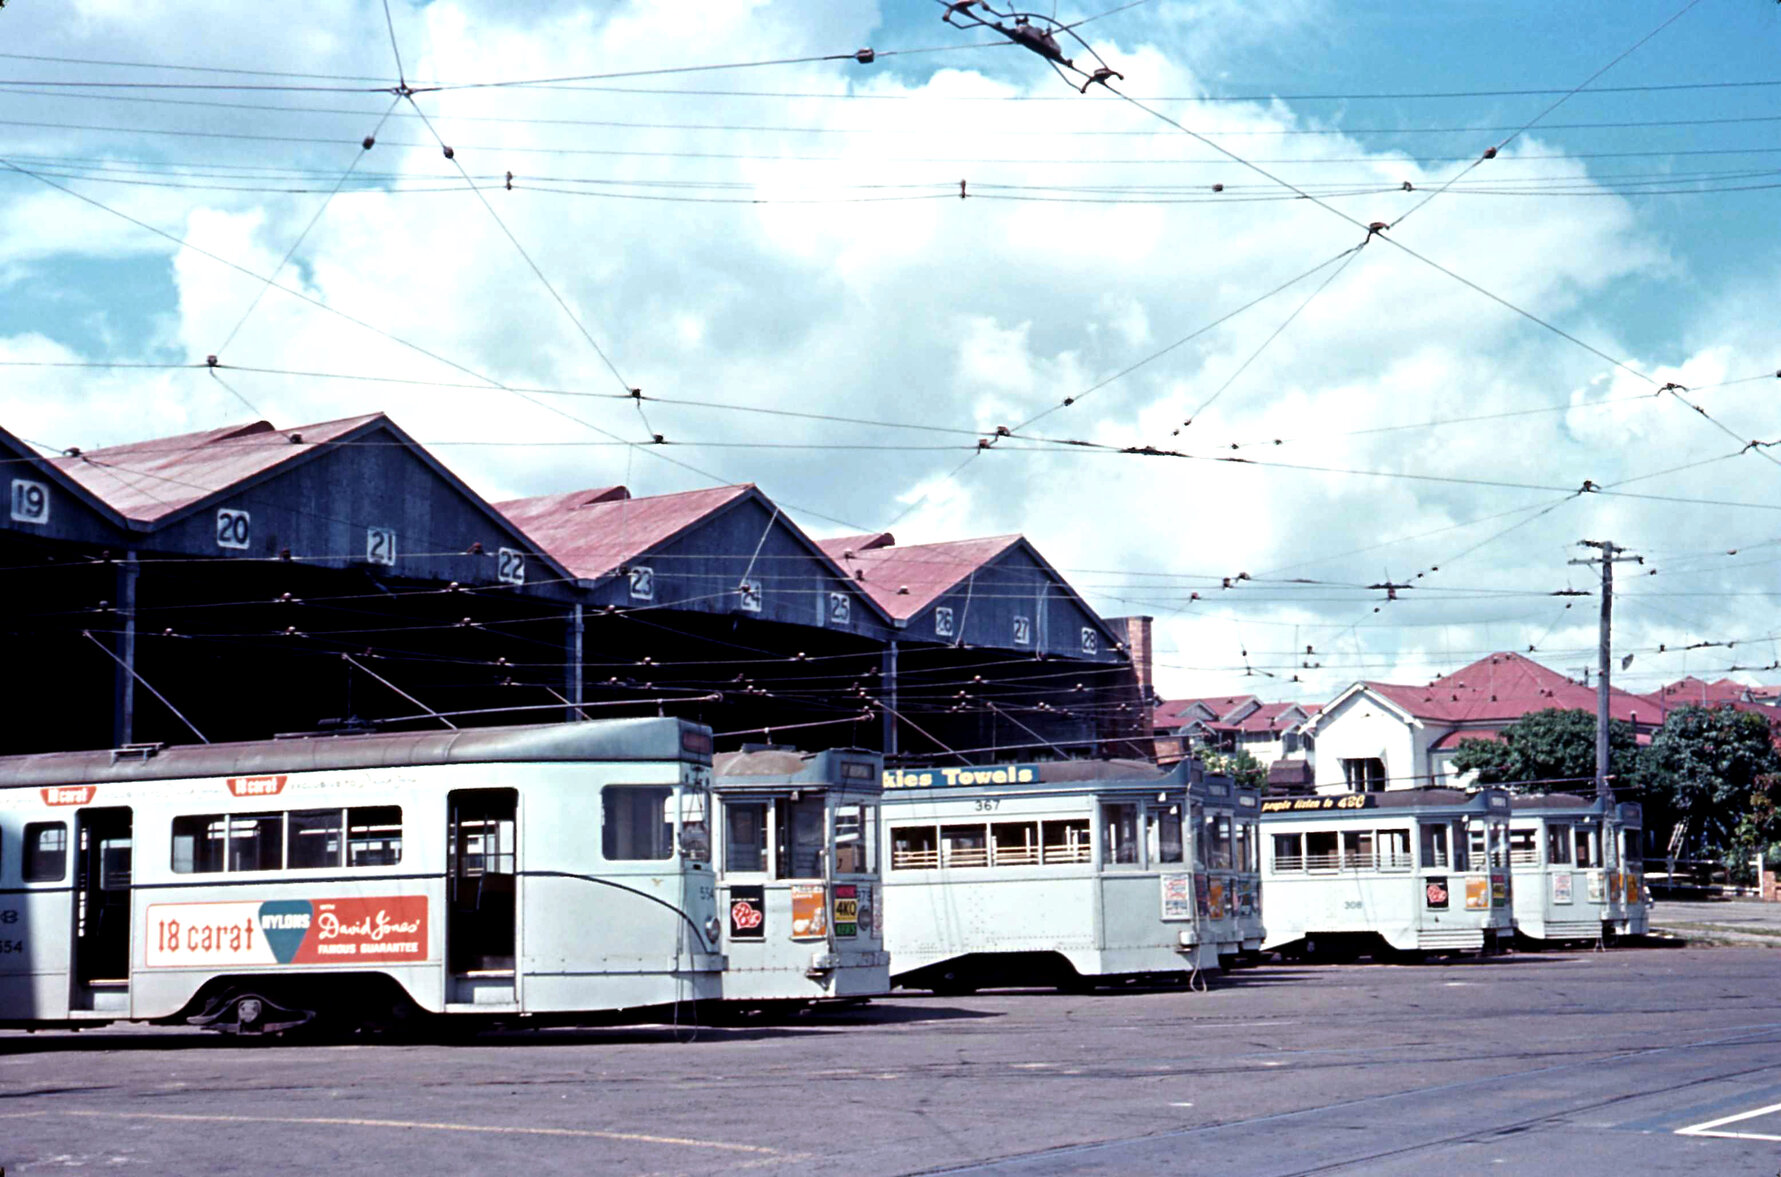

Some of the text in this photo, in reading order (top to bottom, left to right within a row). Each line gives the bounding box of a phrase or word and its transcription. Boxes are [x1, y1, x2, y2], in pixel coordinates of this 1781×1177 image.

[17, 484, 44, 518] 19
[219, 514, 249, 545] 20
[370, 531, 394, 565] 21
[500, 552, 524, 581] 22
[632, 569, 653, 596] 23
[743, 584, 762, 609] 24
[832, 596, 849, 622] 25
[937, 610, 952, 635] 26
[1014, 619, 1029, 643] 27
[1083, 631, 1097, 653] 28
[235, 779, 247, 794] 18
[247, 777, 277, 794] carat
[941, 765, 1033, 787] Towels
[975, 799, 1000, 813] 367
[1262, 799, 1292, 812] people
[1294, 799, 1320, 810] listen
[1323, 798, 1334, 808] to
[261, 913, 311, 930] NYLONS
[318, 912, 371, 940] David
[158, 917, 255, 953] 18 carat
[317, 941, 419, 955] FAMOUS GUARANTEE
